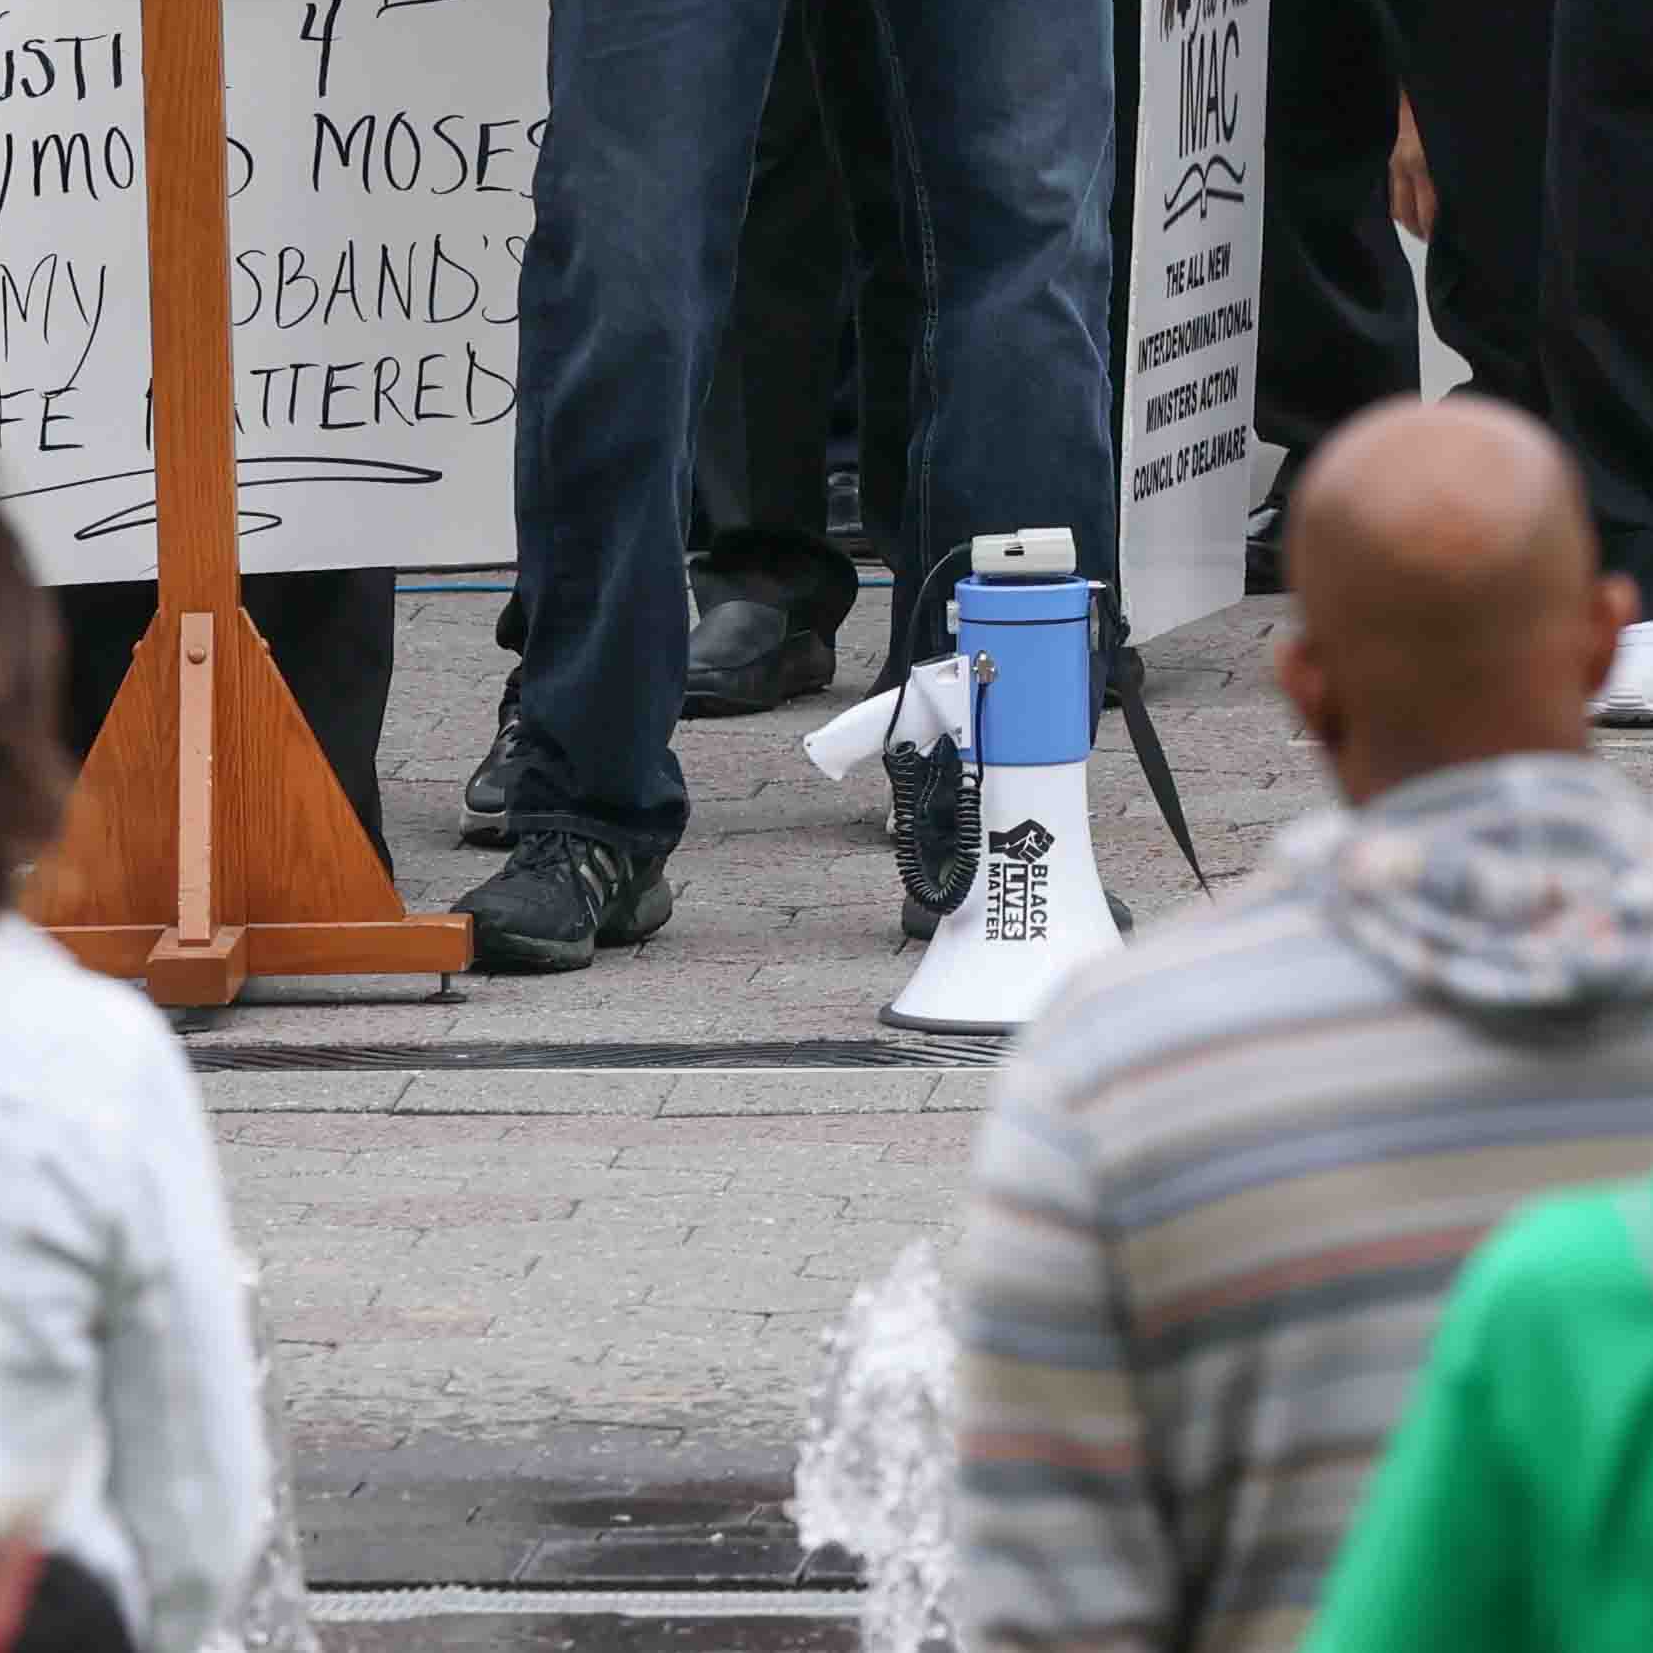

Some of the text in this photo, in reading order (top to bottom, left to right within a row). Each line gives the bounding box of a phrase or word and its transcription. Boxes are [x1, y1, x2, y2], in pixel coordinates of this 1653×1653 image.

[1179, 20, 1240, 158] IMAC
[232, 233, 531, 330] SBAND'S
[1166, 242, 1231, 299] THE ALL NEW
[1137, 297, 1253, 375] INTERDENOMINATIONAL
[1145, 364, 1239, 435] MINISTERS ACTION
[1133, 425, 1247, 503] COUNCIL OF DELAWARE
[985, 862, 1001, 941] MATTER
[1003, 864, 1027, 939] LIVES
[1030, 864, 1048, 940] BLACK
